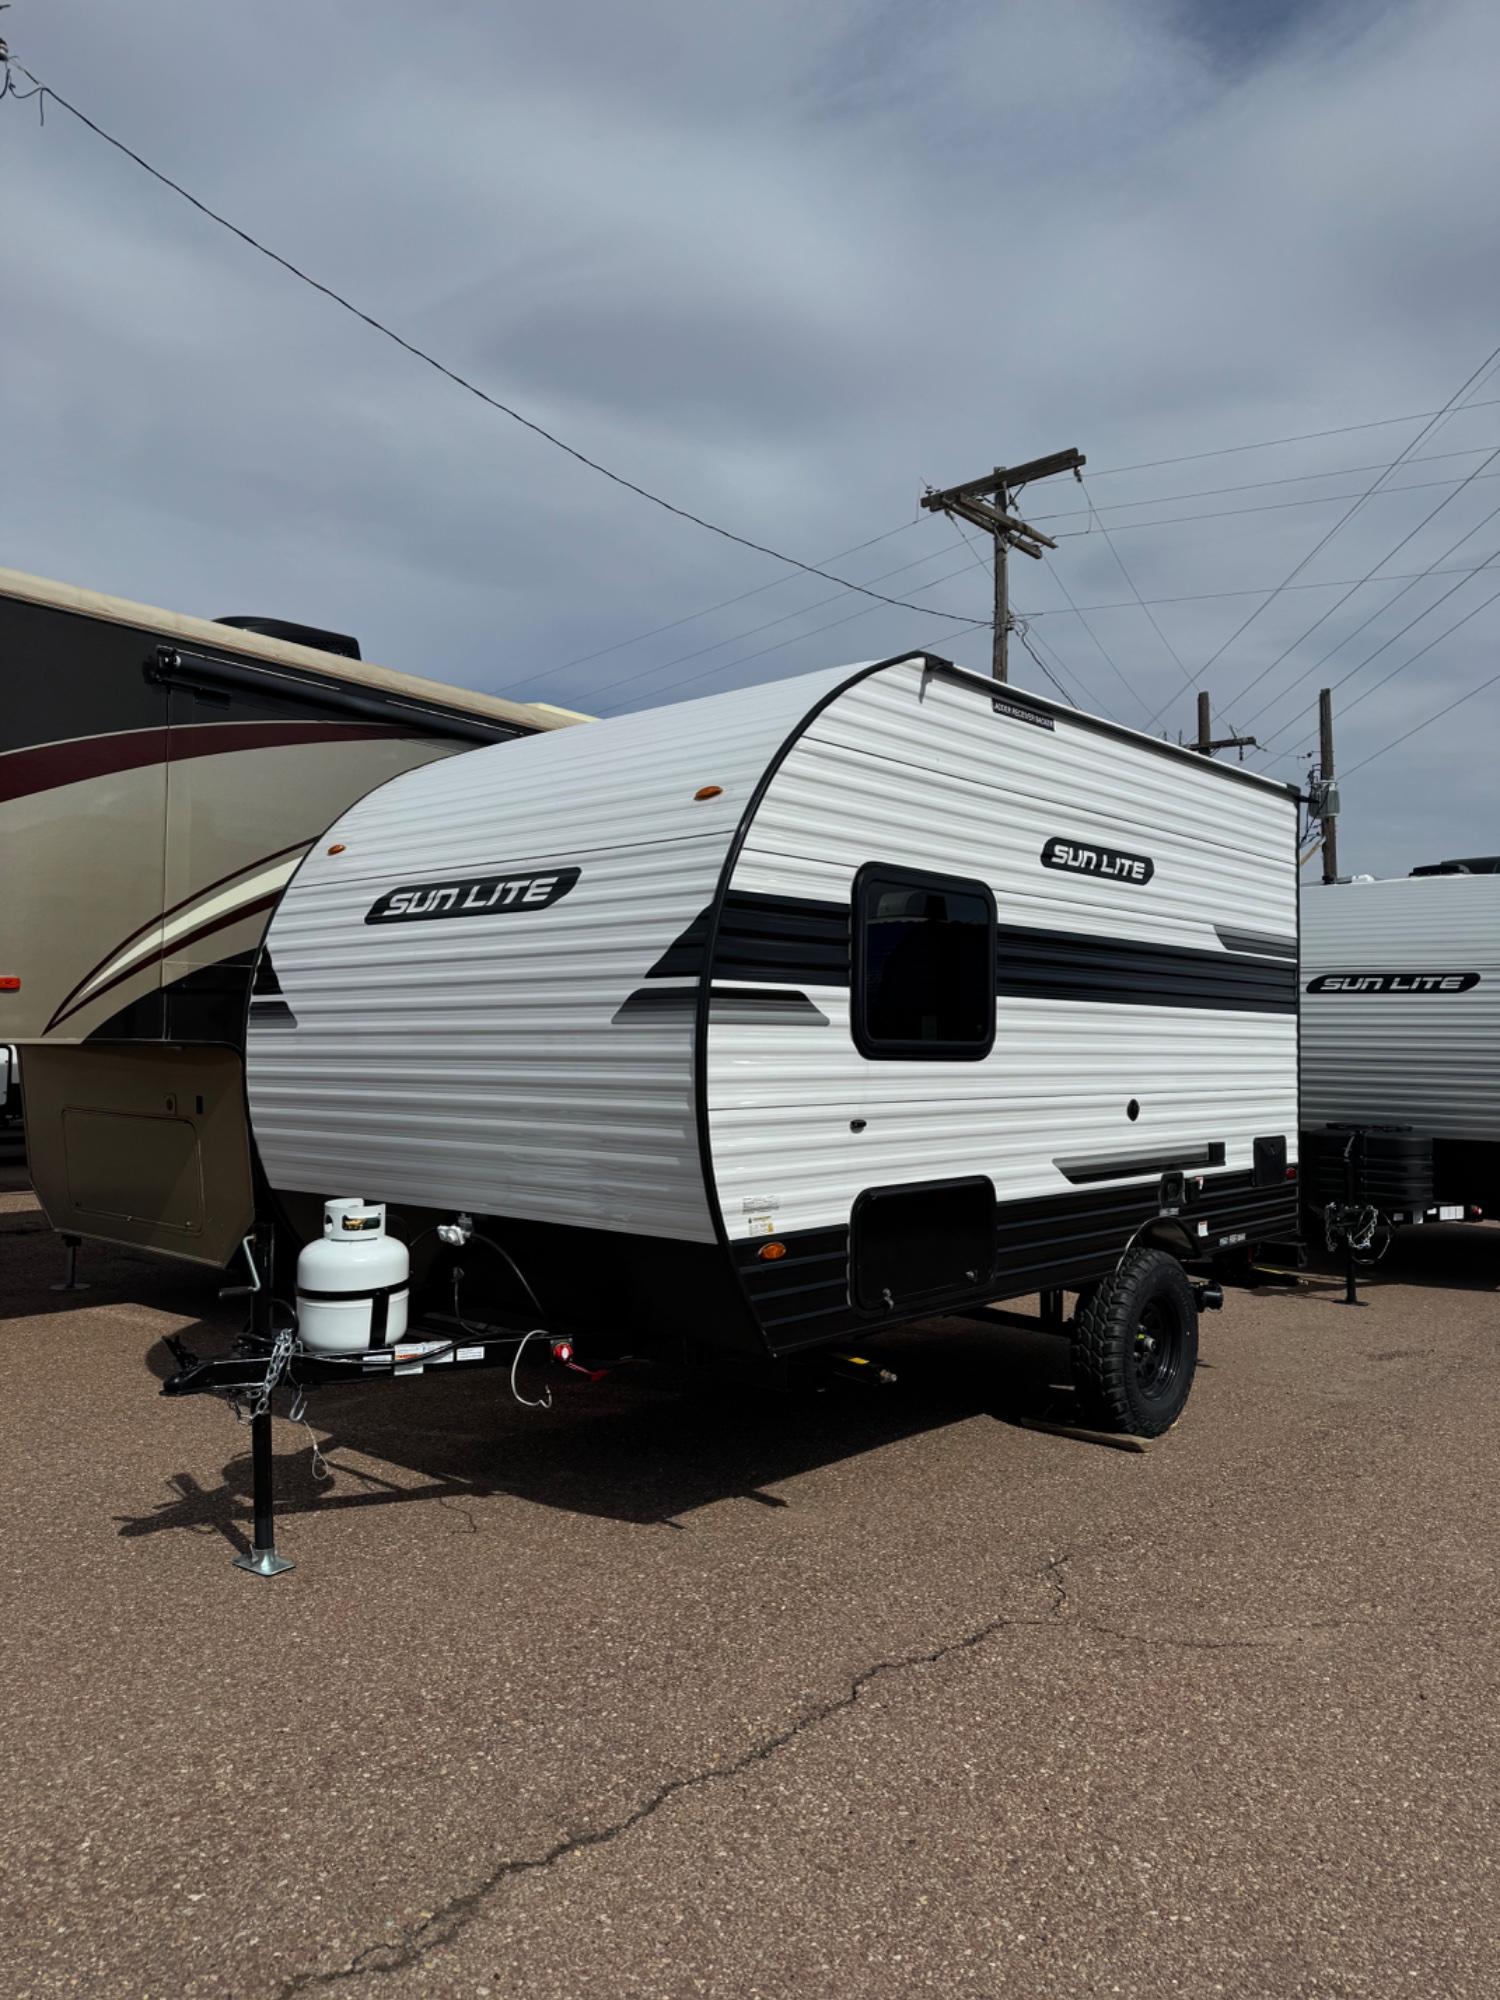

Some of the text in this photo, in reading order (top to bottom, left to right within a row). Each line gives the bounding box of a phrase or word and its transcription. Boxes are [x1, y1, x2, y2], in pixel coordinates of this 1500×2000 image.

[1051, 844, 1146, 880] SUN LITE
[382, 877, 560, 916] SUN LITE
[1320, 976, 1465, 991] SUN LITE
